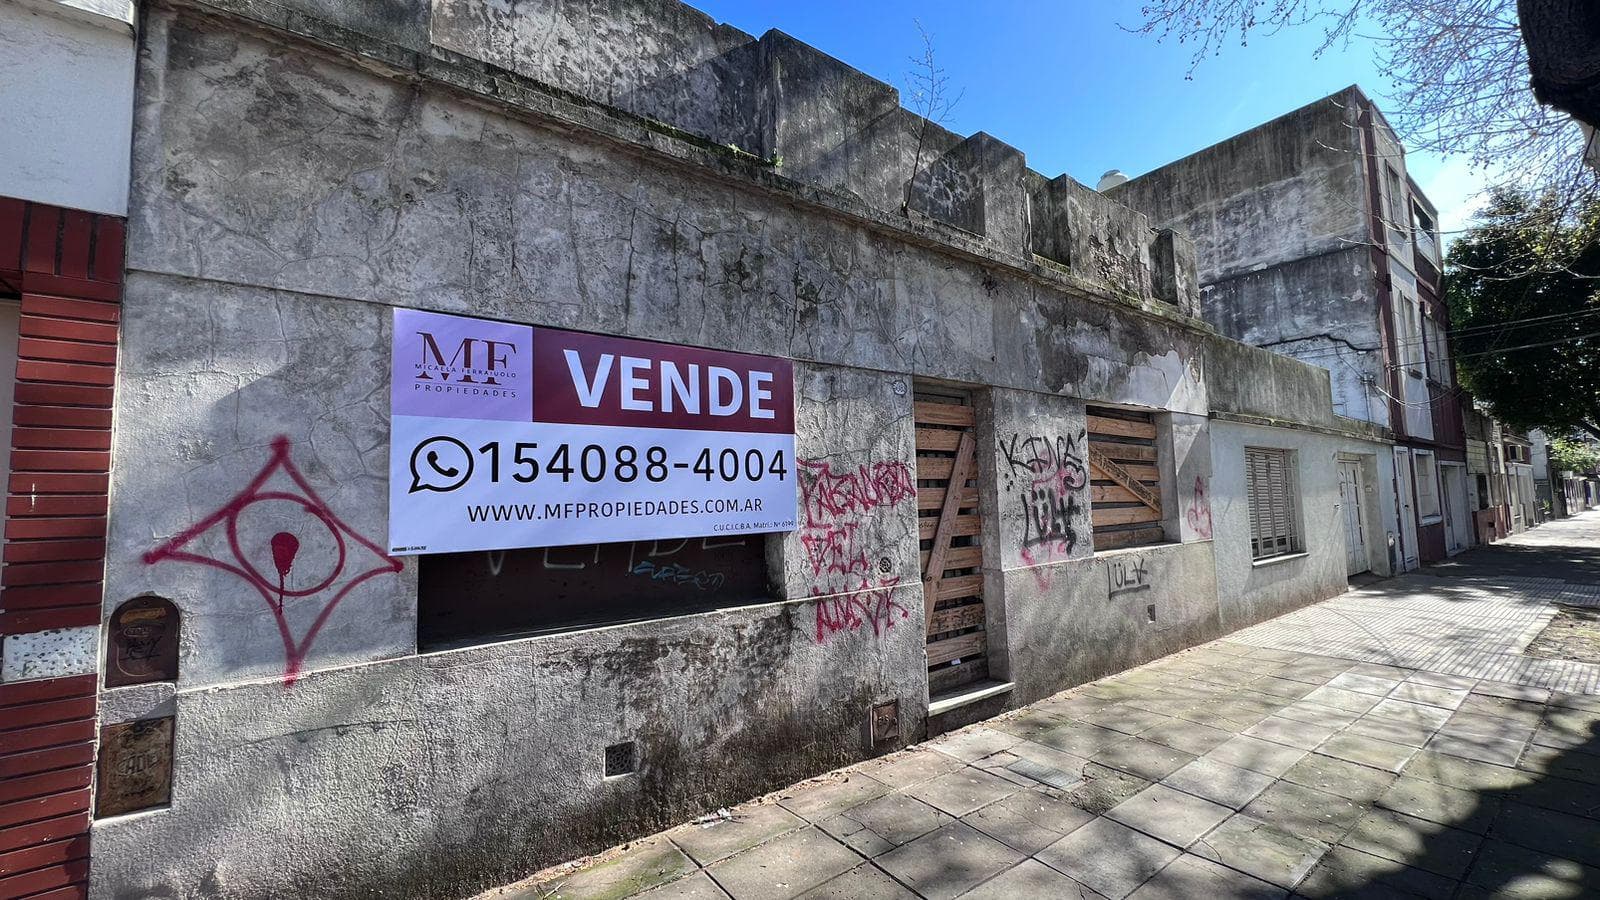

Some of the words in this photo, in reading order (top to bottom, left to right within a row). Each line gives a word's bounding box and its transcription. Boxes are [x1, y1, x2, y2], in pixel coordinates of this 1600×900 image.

[416, 331, 517, 386] MF
[414, 383, 517, 399] PROPIEDADES
[563, 349, 776, 420] VENDE
[478, 441, 788, 483] 154088-4004
[466, 498, 763, 523] WWW.MFPROPIEDADES.COM.AR
